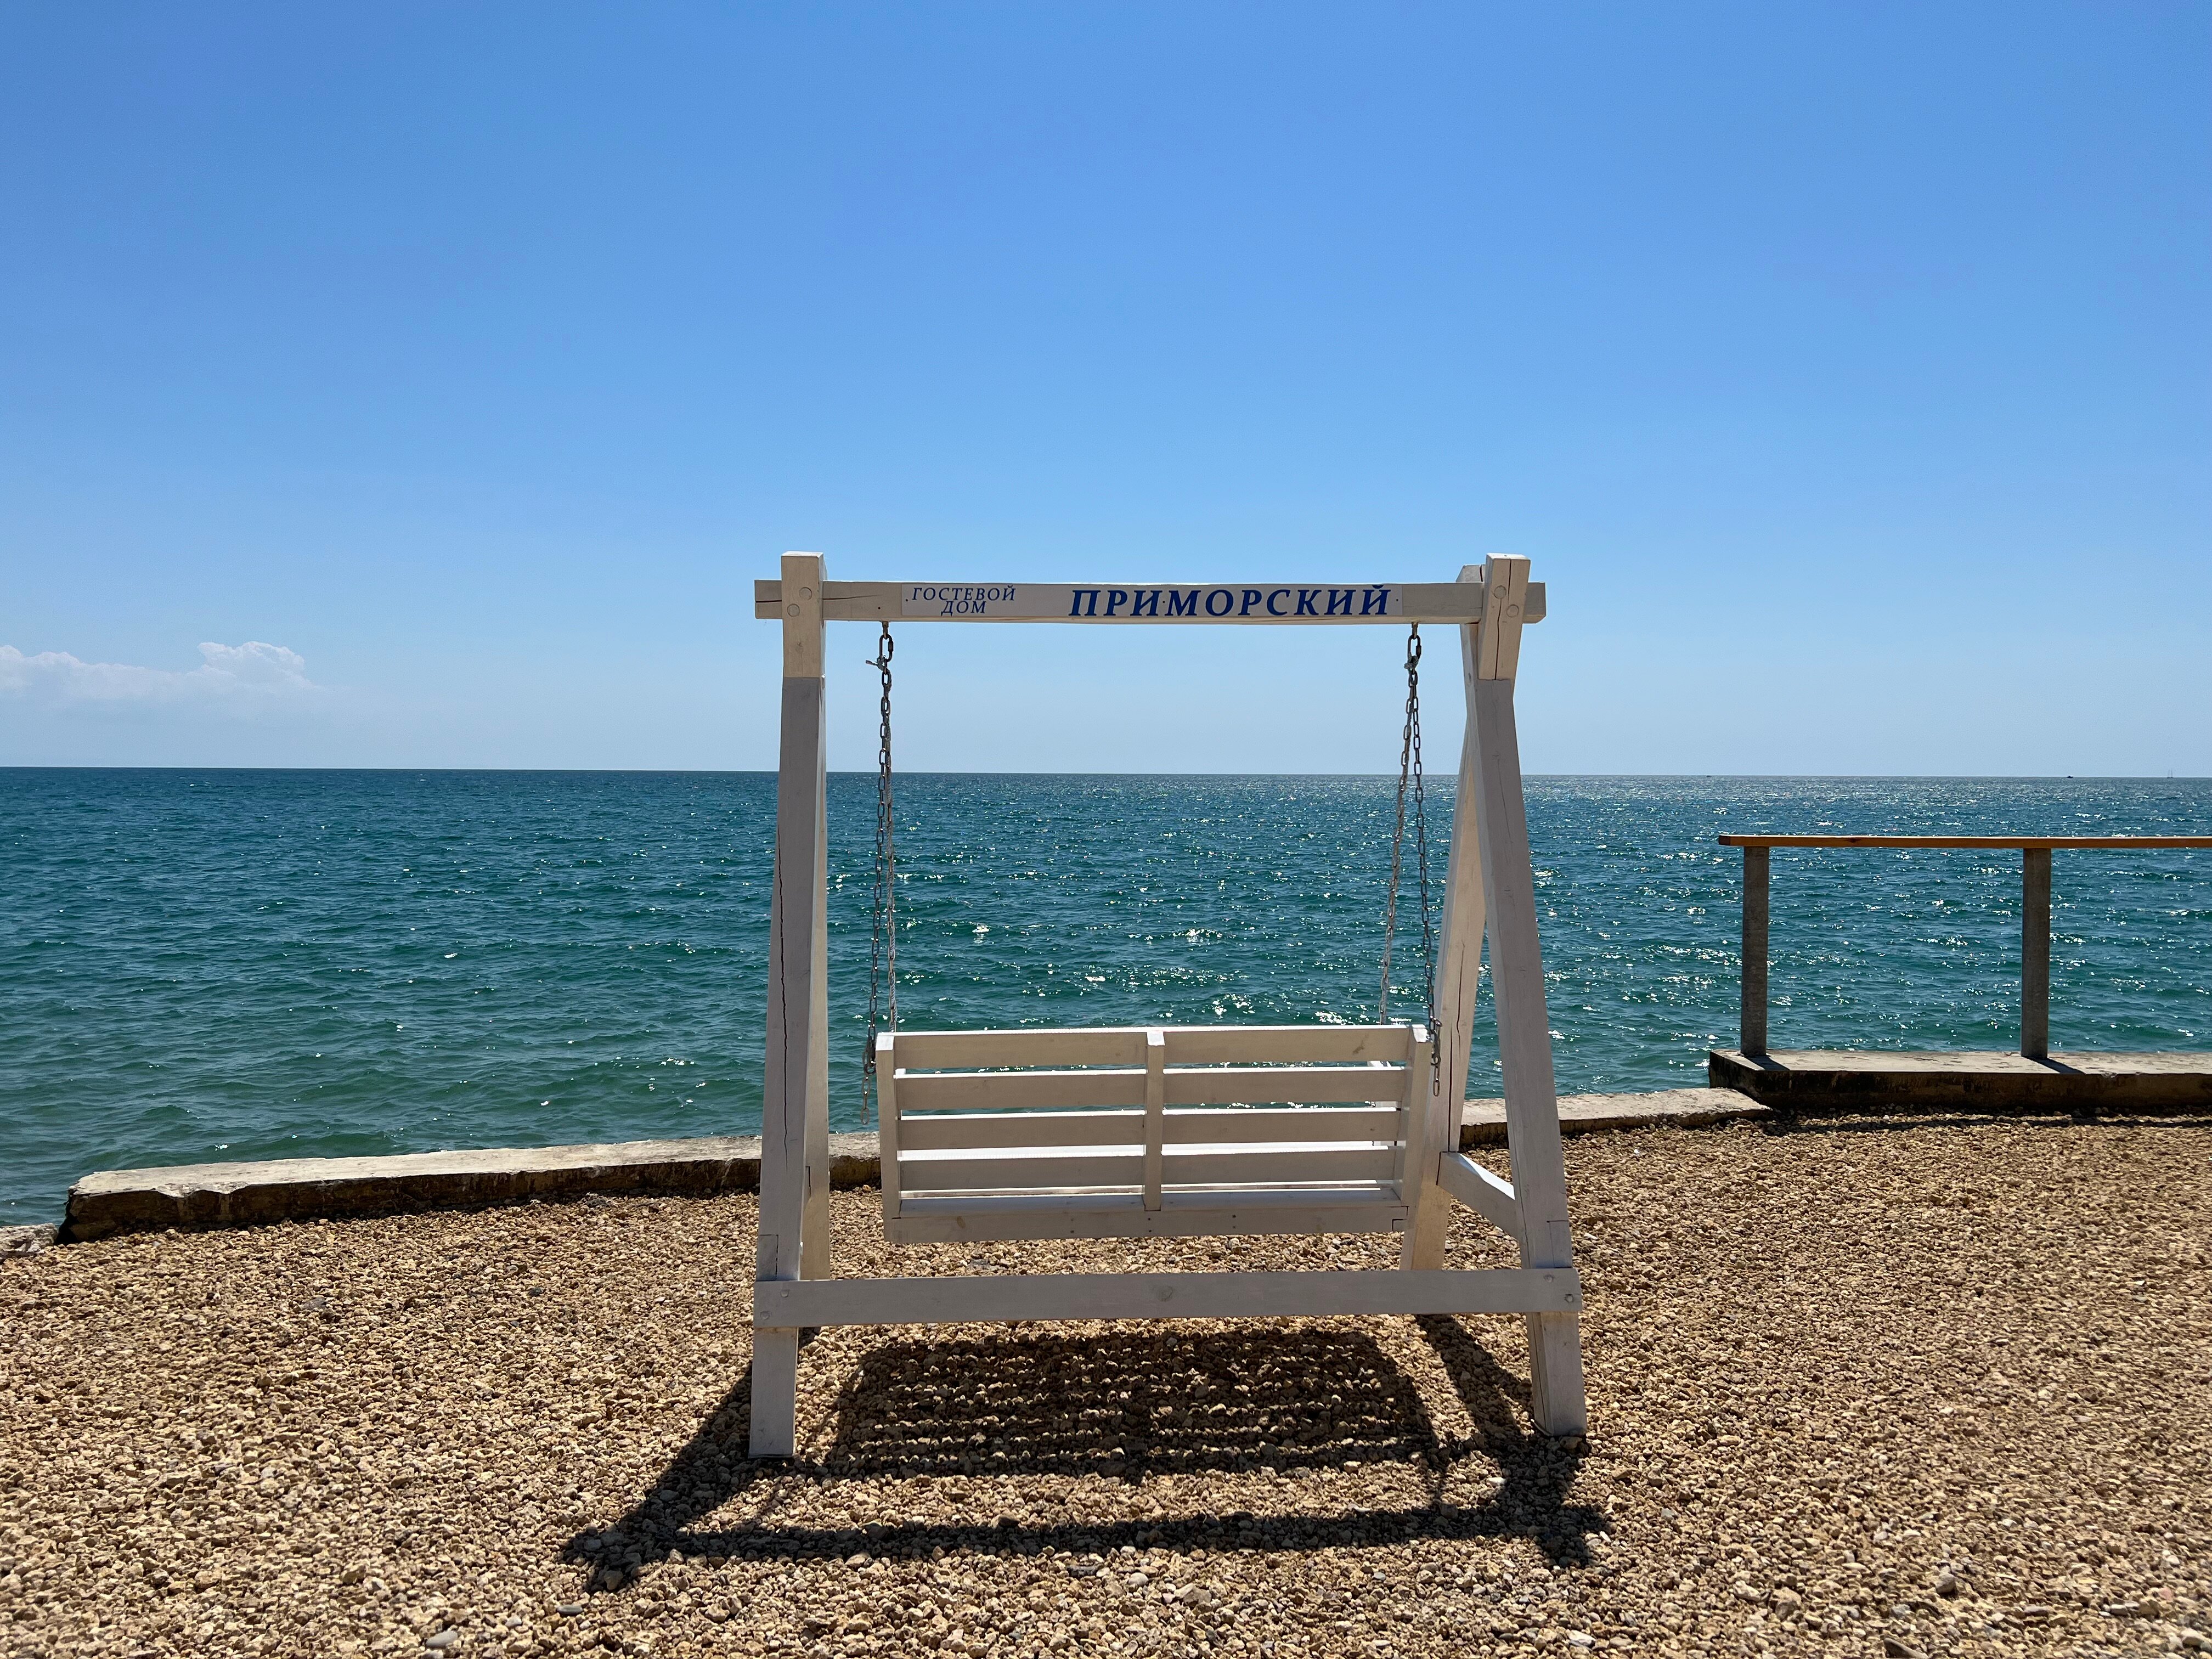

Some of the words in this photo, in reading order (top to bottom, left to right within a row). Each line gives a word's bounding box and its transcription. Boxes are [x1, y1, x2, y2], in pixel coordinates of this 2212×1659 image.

[912, 585, 1016, 601] ГОСТЕВОЙ
[1068, 585, 1391, 616] ПРИМОРСКИЙ
[941, 600, 986, 617] ДОМ
